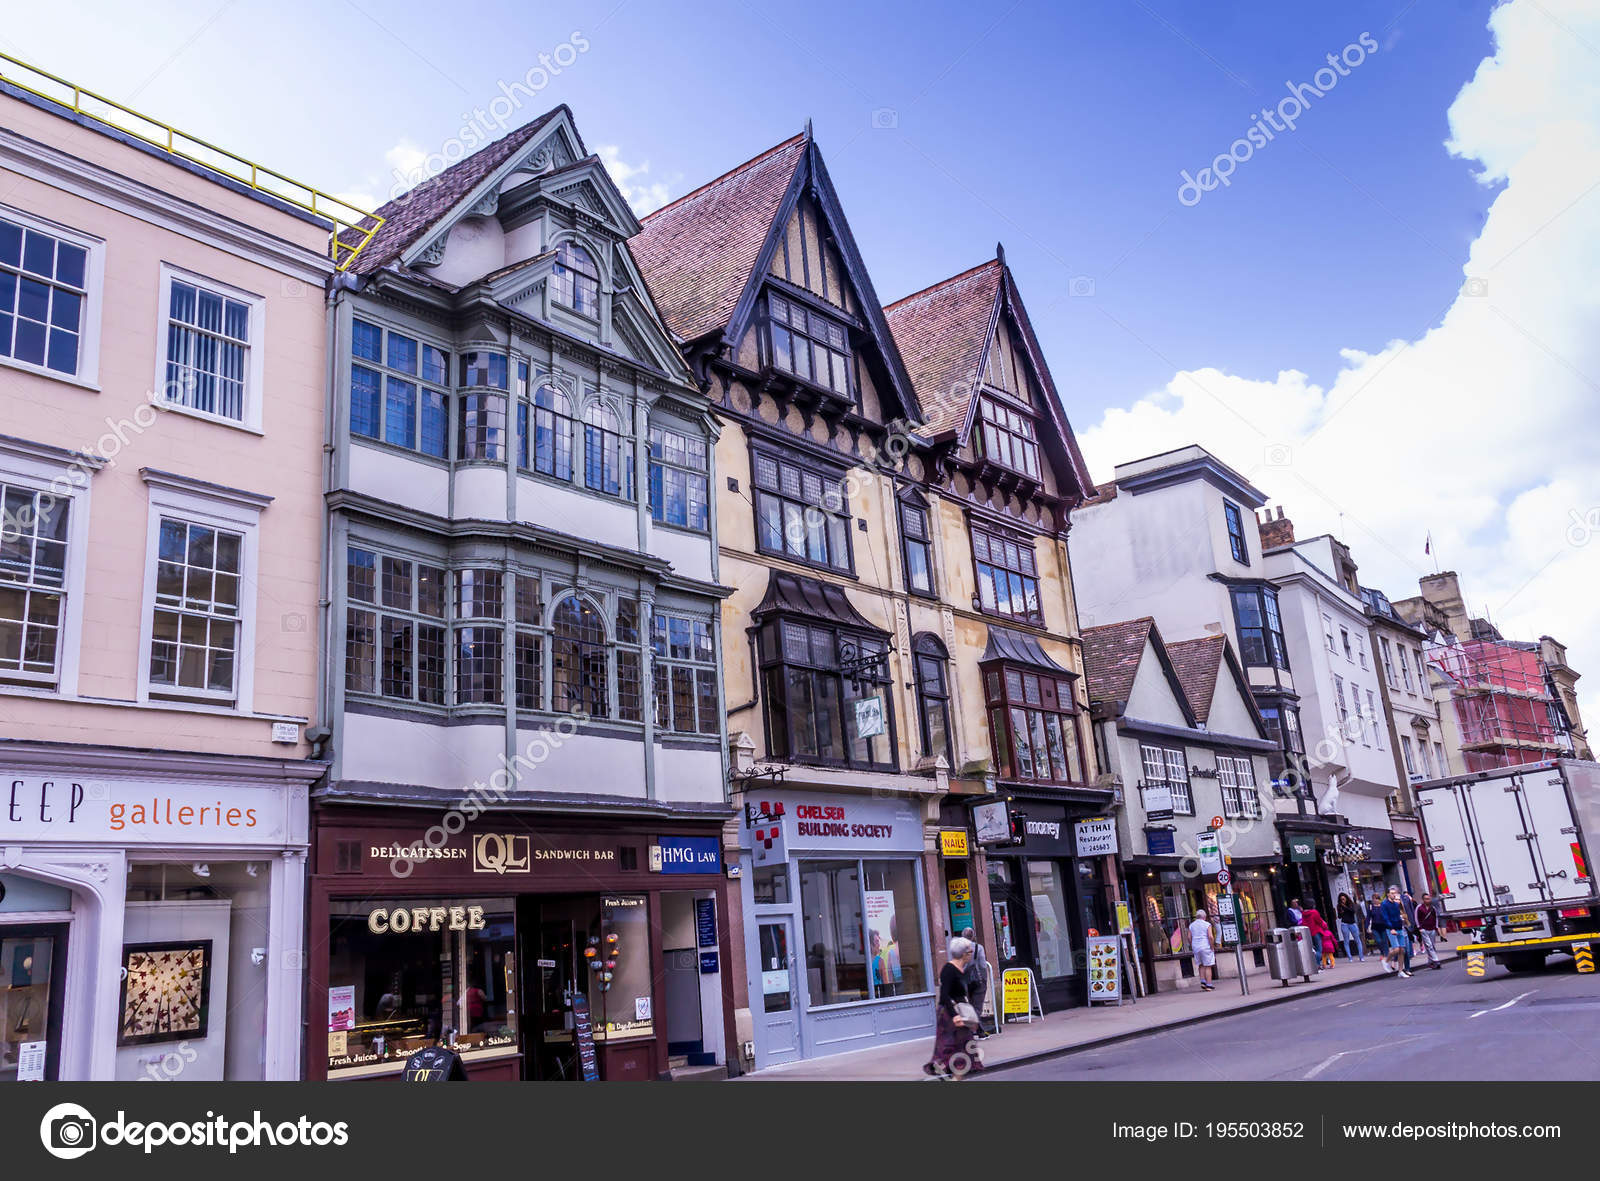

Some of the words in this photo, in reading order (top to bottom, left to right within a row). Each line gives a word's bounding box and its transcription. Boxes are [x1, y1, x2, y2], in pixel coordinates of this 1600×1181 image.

[110, 798, 257, 830] galleries
[796, 805, 845, 820] CHELSEA
[797, 822, 849, 837] BUILDING
[851, 823, 892, 838] SOCIETY
[1091, 824, 1110, 832] THAI
[944, 838, 965, 848] NAILS
[1079, 834, 1112, 843] Restaurant
[371, 846, 467, 859] DELICATESSEN
[476, 833, 527, 875] QL
[535, 850, 590, 860] SANDWICH
[594, 850, 614, 860] BAR
[663, 847, 694, 862] HMG
[697, 852, 716, 862] LAW
[368, 906, 486, 934] COFFEE
[1005, 977, 1028, 985] NAILS
[329, 1056, 352, 1066] Fresh
[353, 1053, 378, 1063] Juices
[453, 1042, 472, 1052] Soup
[488, 1036, 512, 1046] Salads
